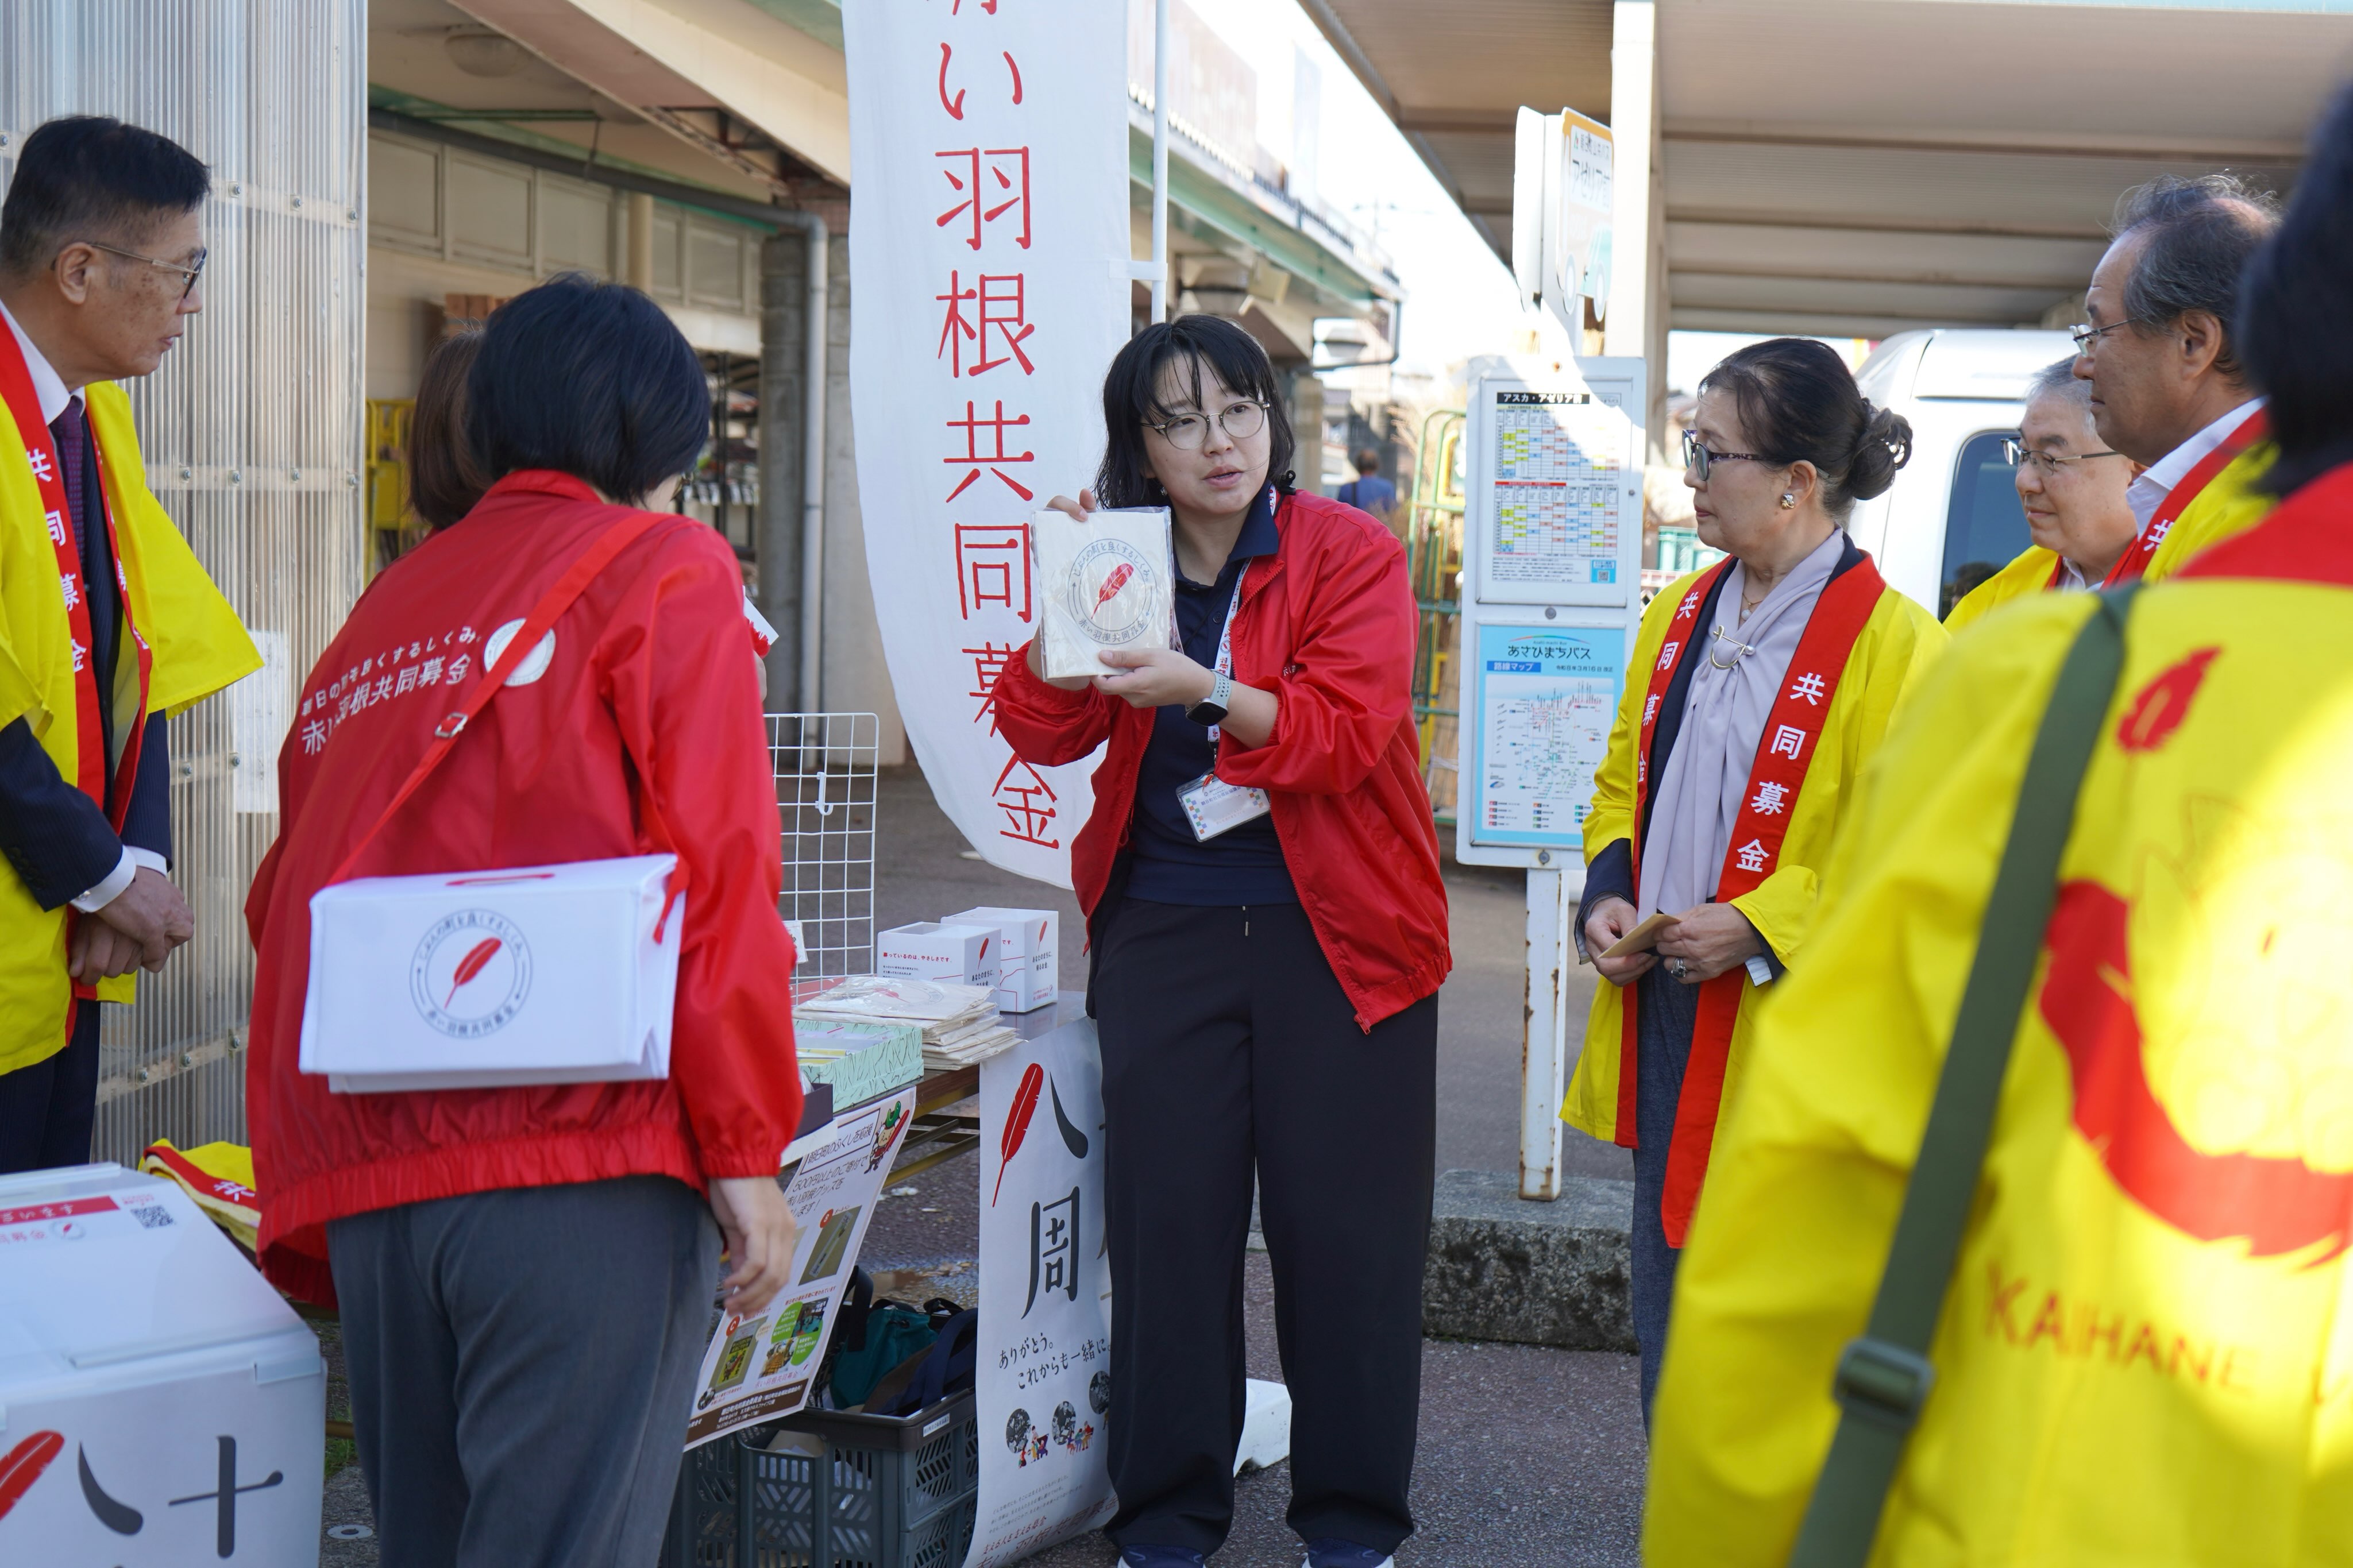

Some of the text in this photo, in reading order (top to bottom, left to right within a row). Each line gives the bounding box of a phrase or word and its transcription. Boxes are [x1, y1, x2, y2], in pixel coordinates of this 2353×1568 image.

[1508, 645, 1591, 660] あさひまちバス
[1494, 662, 1534, 672] 路線マップ
[1737, 672, 1825, 872] 共同募金
[823, 1213, 830, 1223] B
[730, 1320, 736, 1331] C
[998, 1332, 1054, 1369] ありがとう。
[1017, 1339, 1111, 1389] これからも一緒に。
